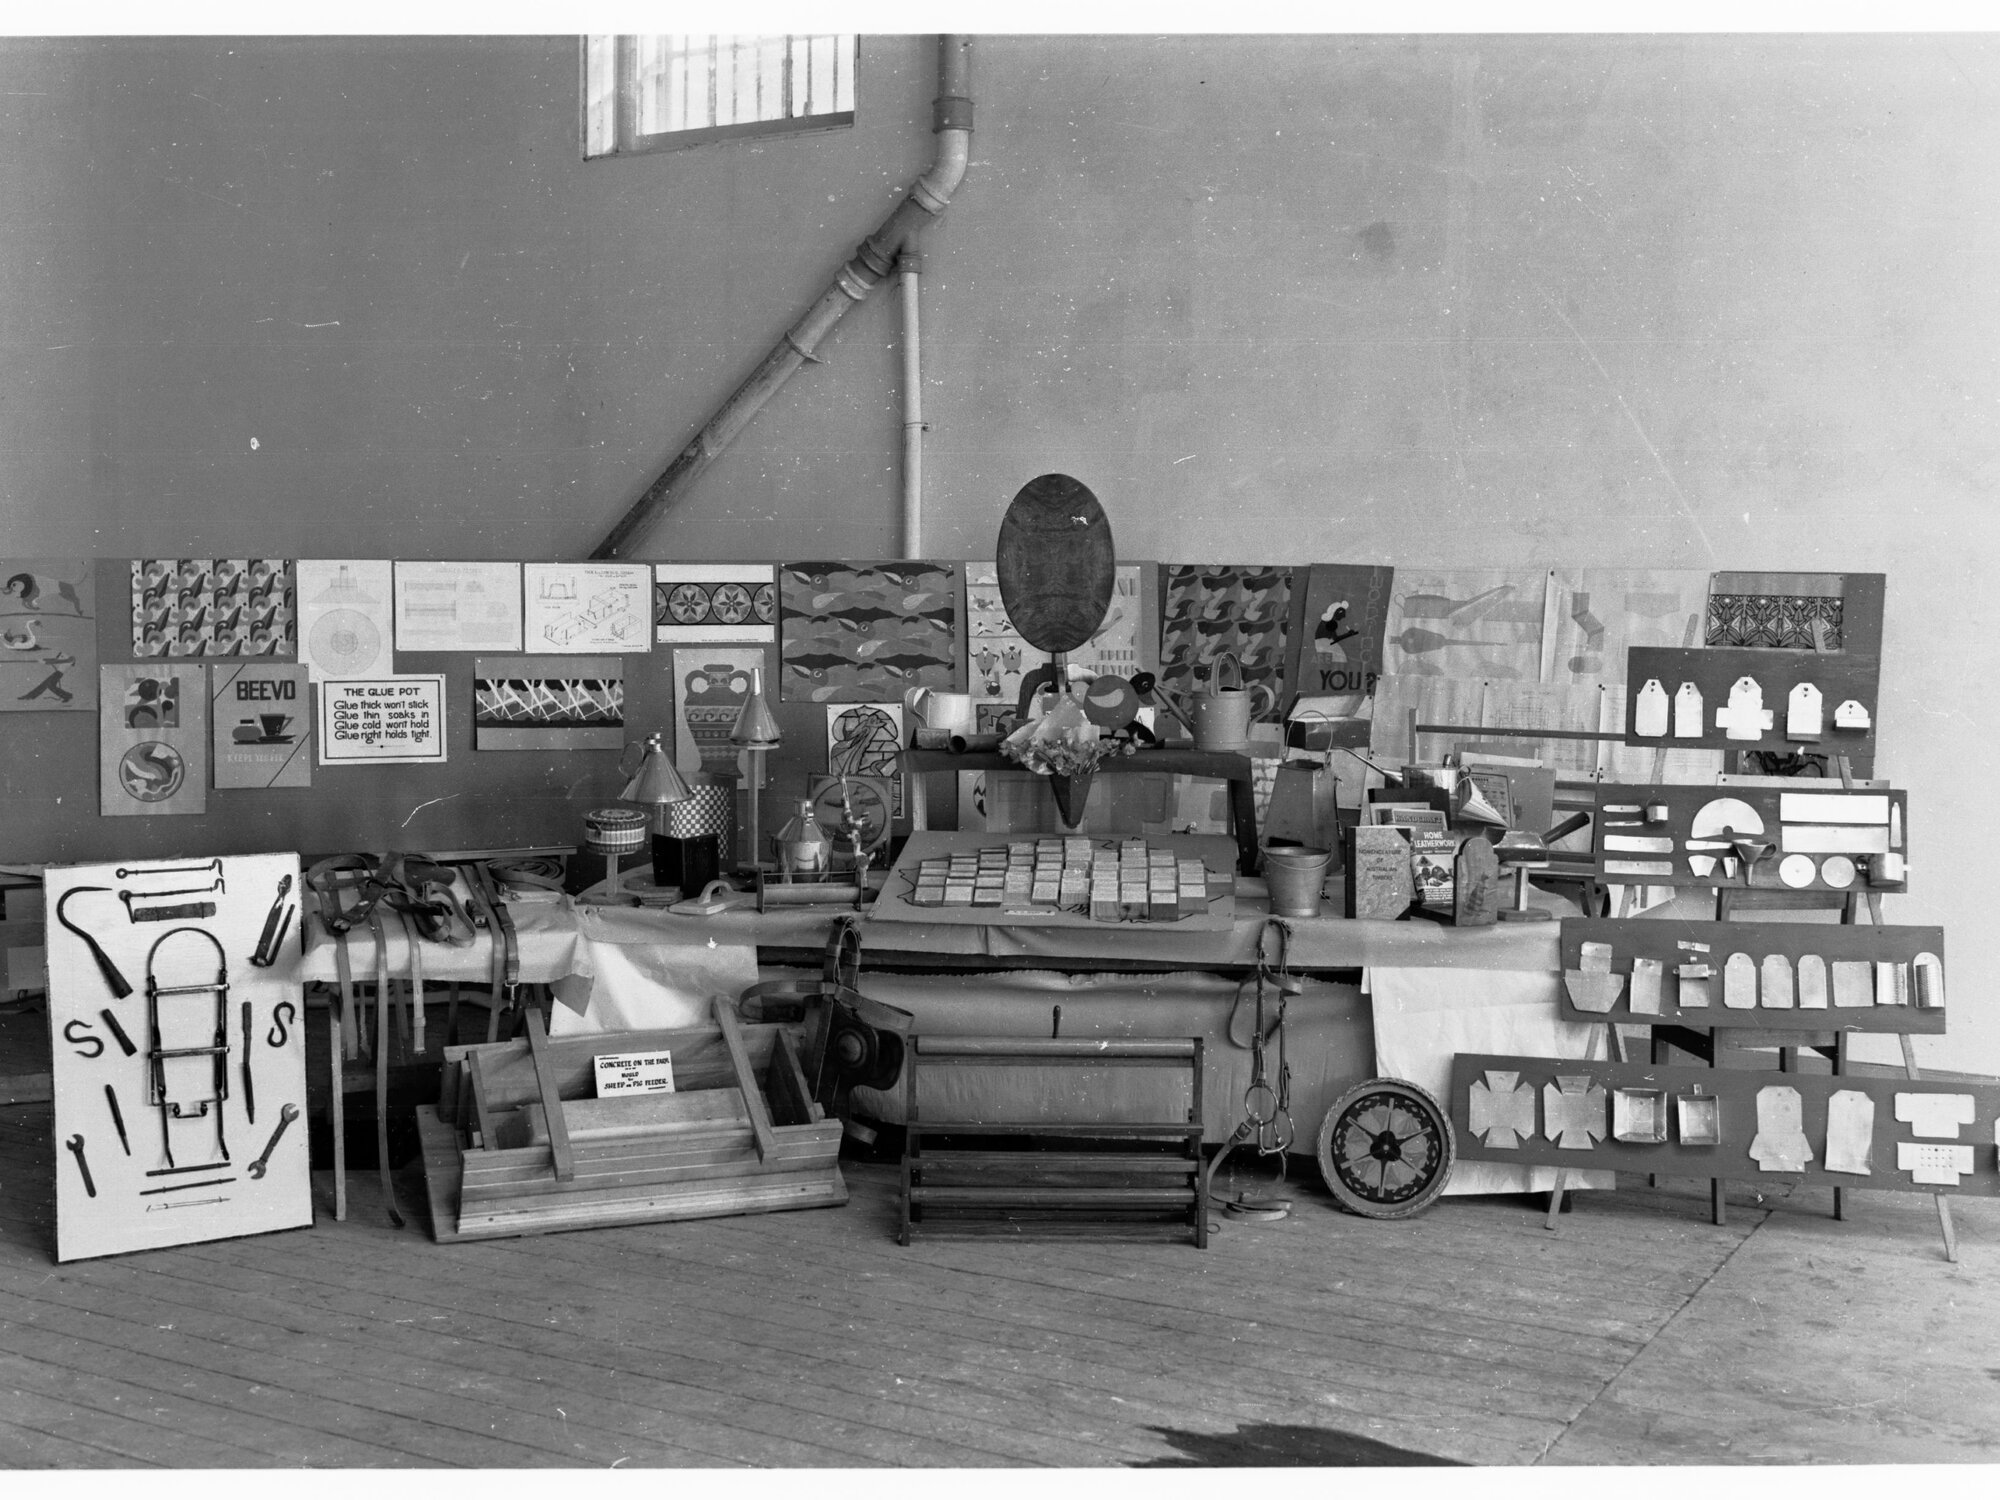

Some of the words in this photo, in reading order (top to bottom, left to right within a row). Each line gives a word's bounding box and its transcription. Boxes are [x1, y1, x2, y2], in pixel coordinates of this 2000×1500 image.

[1310, 652, 1333, 664] ARE
[236, 680, 296, 701] BEEVO
[344, 688, 365, 697] THE
[368, 687, 395, 697] GLUE
[398, 687, 421, 696] POT
[333, 700, 359, 710] Glue
[360, 700, 382, 710] thick
[408, 700, 429, 709] stick
[333, 710, 359, 720] Glue
[363, 710, 381, 720] thin
[387, 710, 416, 719] soaks
[421, 710, 430, 719] in
[334, 720, 360, 730] Glue
[361, 720, 381, 729] cold
[410, 719, 429, 729] hold
[334, 730, 360, 741] Glue
[360, 730, 383, 745] right
[385, 729, 408, 740] holds
[1423, 831, 1443, 839] HOME
[1414, 839, 1456, 848] LEATHERWORK
[600, 1060, 632, 1069] CONCRETE
[604, 1081, 625, 1089] SHEEP
